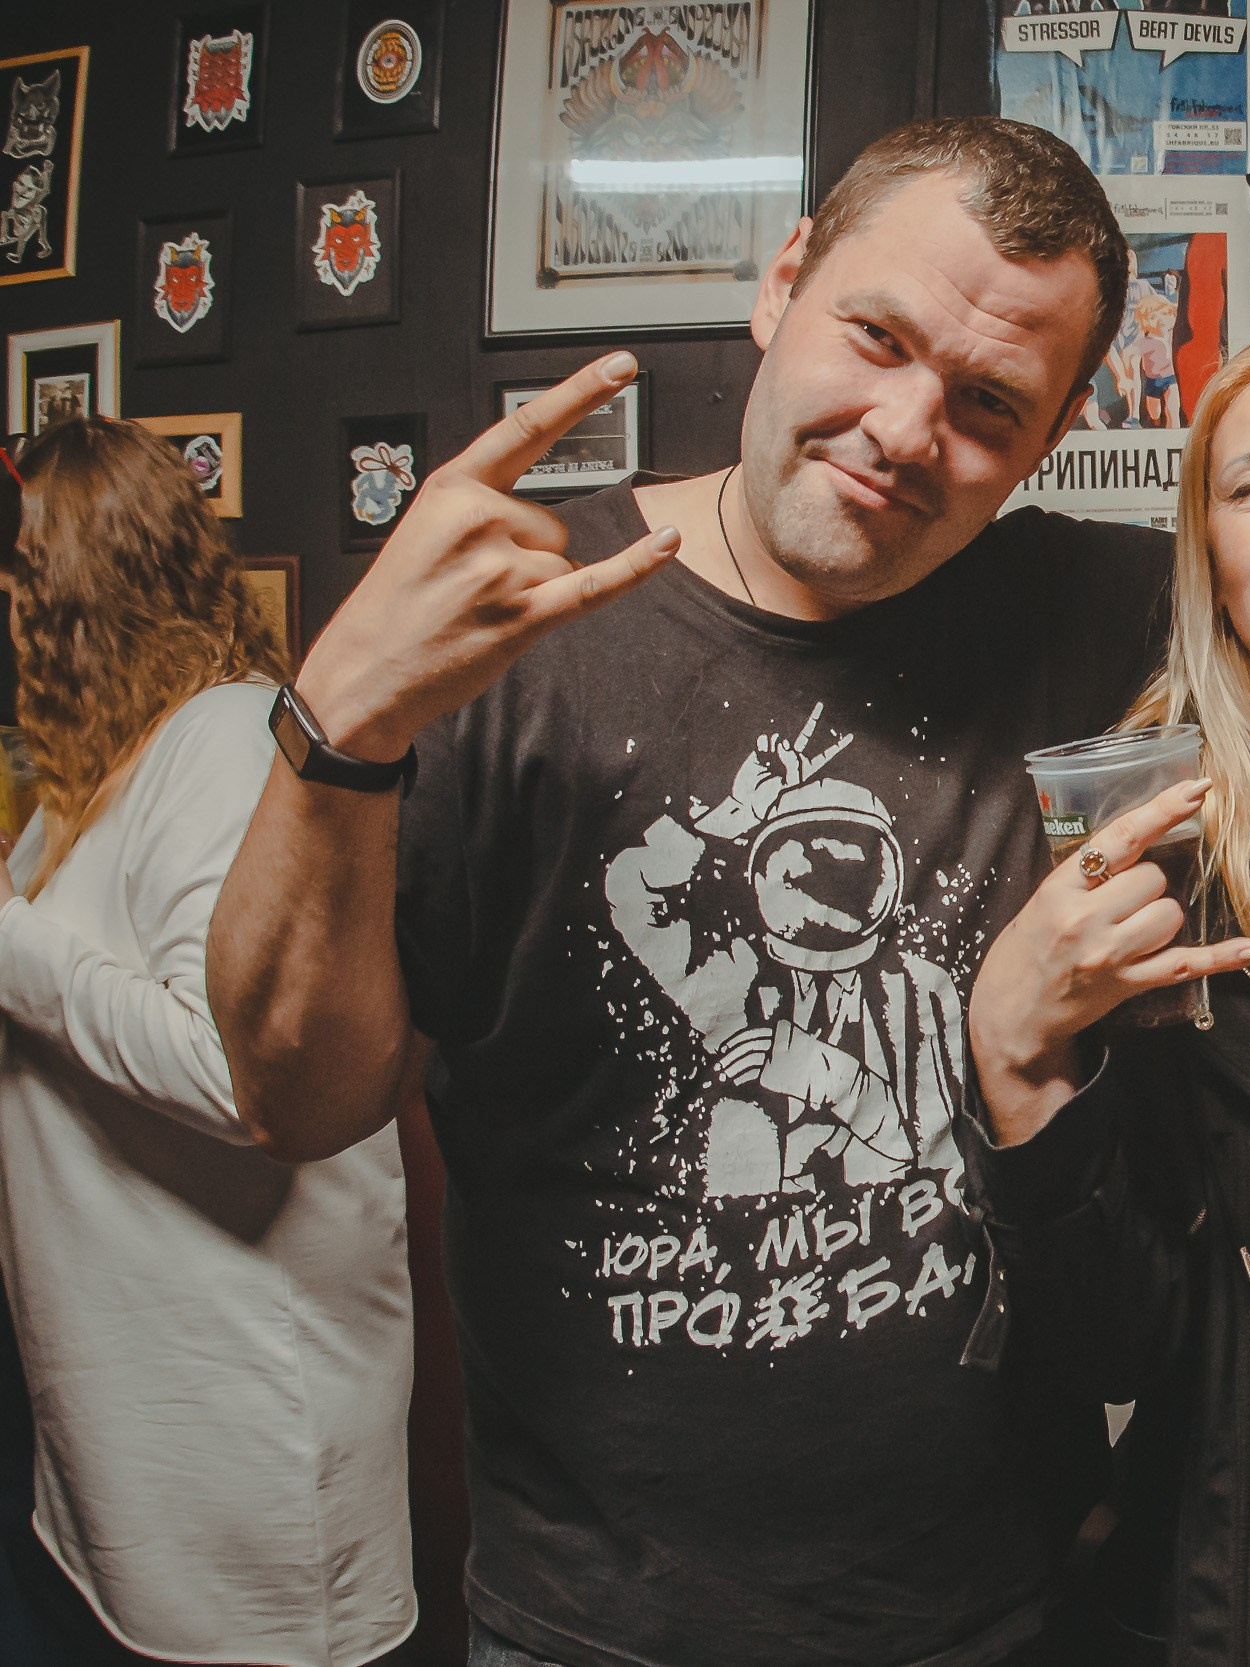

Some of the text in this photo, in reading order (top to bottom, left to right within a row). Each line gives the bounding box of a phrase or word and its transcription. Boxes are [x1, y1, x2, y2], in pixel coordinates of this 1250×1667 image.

[1018, 19, 1101, 42] STRESSOR
[1139, 19, 1235, 44] BEAT DEVILS
[1044, 818, 1086, 836] neken
[603, 1226, 731, 1284] ЮРА,
[757, 1191, 873, 1272] МЫ
